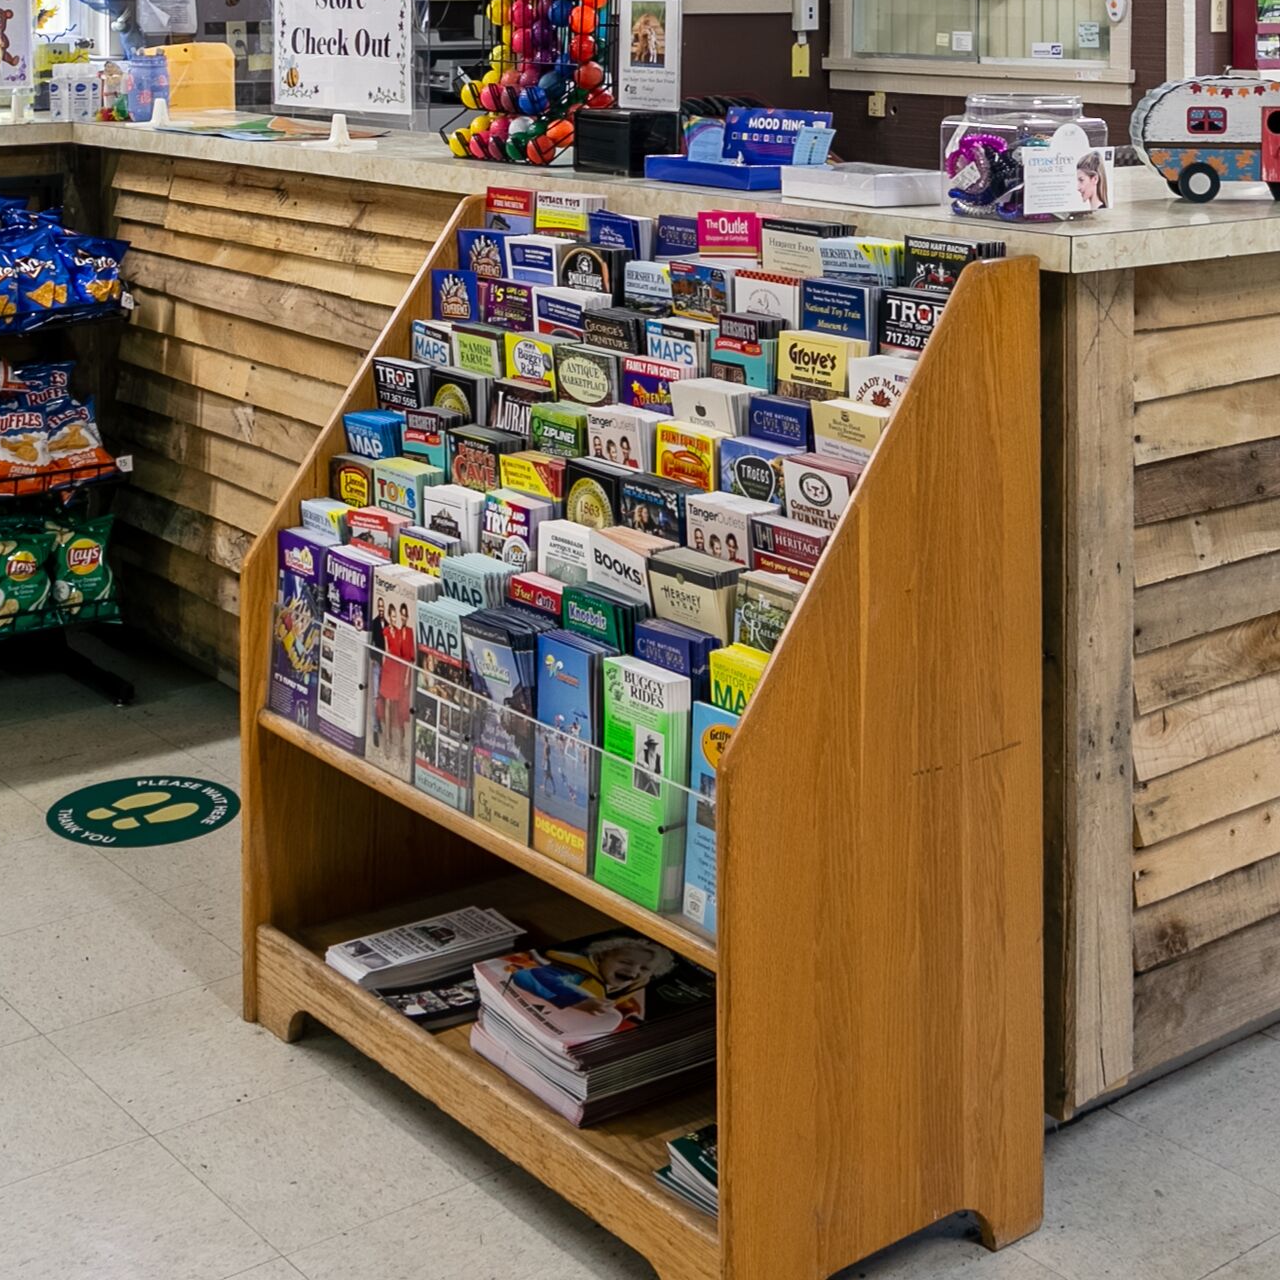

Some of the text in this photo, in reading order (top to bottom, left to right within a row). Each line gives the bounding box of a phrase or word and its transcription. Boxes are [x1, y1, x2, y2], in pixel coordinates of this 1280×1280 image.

[291, 27, 391, 58] Check Out
[749, 118, 805, 131] MOOD RING
[1028, 154, 1074, 166] creasefree
[538, 195, 580, 208] OUTBACK TOYS
[706, 217, 749, 236] The Outlet
[769, 237, 815, 253] HERSHEY FARM
[908, 239, 969, 254] INDOOR KART RACING
[822, 259, 847, 268] CHOCOLATE
[805, 301, 861, 320] National Toy Train
[585, 320, 624, 337] GEORGE'S
[721, 319, 757, 340] HERSHEY'S
[414, 337, 448, 364] MAPS
[468, 341, 492, 356] AMISH
[585, 333, 629, 350] FURNITURE
[651, 337, 692, 360] MAPS
[460, 352, 482, 364] FARM
[517, 347, 544, 366] Buggy
[788, 343, 837, 370] Grove's
[378, 366, 414, 387] TROP
[520, 362, 542, 378] Rides
[566, 360, 599, 378] ANTIQUE
[625, 360, 680, 380] FAMILY FUN CENTER
[790, 373, 813, 384] Homemade
[562, 372, 607, 392] MARKETPLACE
[855, 376, 881, 400] SHADY
[379, 390, 418, 408] 717.367.5585
[497, 391, 532, 436] LURAY
[543, 424, 576, 444] ZIPLINES
[349, 433, 383, 458] MAP
[345, 476, 366, 488] Lincoln
[453, 460, 497, 489] CAVE
[377, 478, 416, 508] TOYS
[579, 501, 600, 517] 1863
[790, 499, 824, 517] COUNTRY
[485, 510, 507, 534] TRY
[774, 534, 820, 556] HERITAGE
[68, 546, 100, 565] Lay's
[761, 556, 775, 566] Start
[776, 560, 788, 571] your
[789, 564, 799, 572] visit
[327, 559, 367, 589] Experience
[594, 547, 642, 586] BOOKS
[444, 584, 483, 606] MAP
[513, 582, 534, 600] Free!
[661, 585, 701, 606] HERSHEY
[568, 602, 607, 631] Knoebels
[670, 599, 700, 615] STORY
[420, 624, 458, 656] MAP
[624, 669, 665, 696] BUGGY
[630, 686, 665, 709] RIDES
[137, 780, 229, 826] PLEASE WAIT HERE
[58, 809, 117, 844] THANK YOU
[535, 815, 584, 850] DISCOVER
